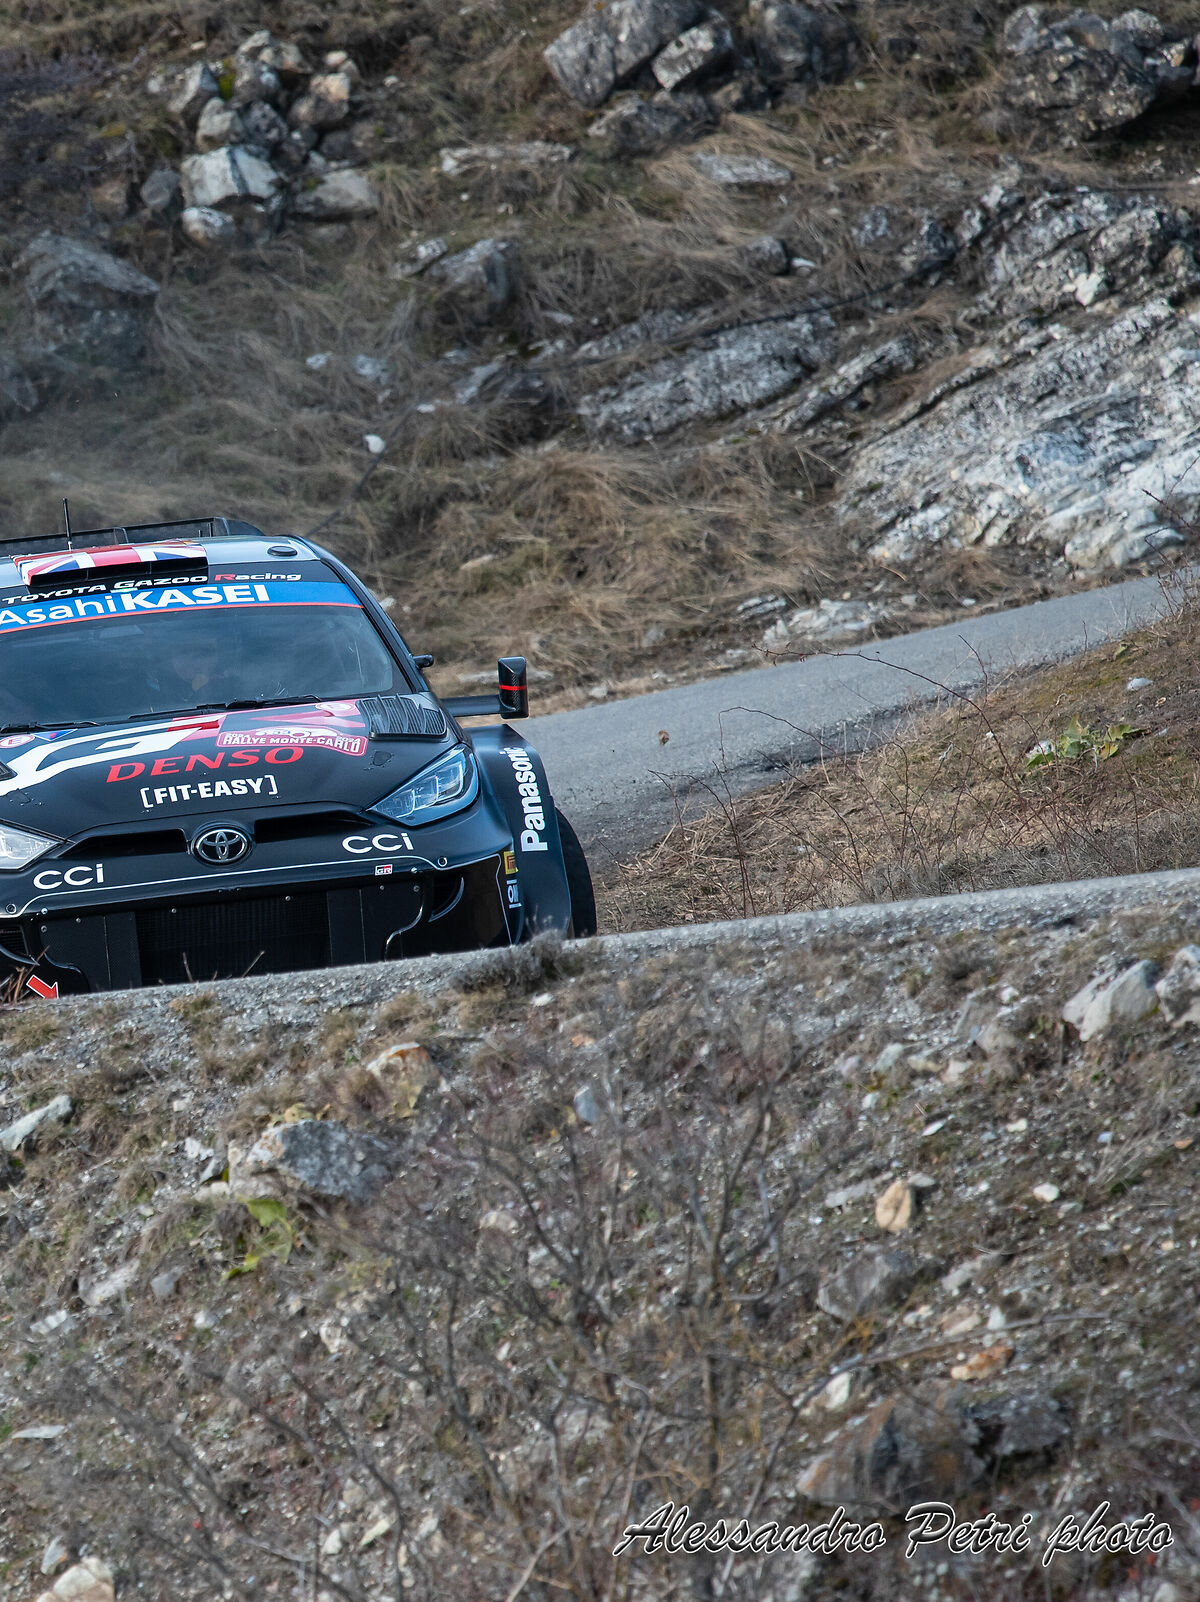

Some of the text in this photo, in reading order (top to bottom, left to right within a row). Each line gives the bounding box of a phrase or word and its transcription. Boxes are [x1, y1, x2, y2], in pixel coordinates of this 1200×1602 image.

[2, 572, 302, 604] TOYOTA GAZOO Racing
[105, 746, 304, 784] DENSO
[499, 747, 549, 852] Panasonic
